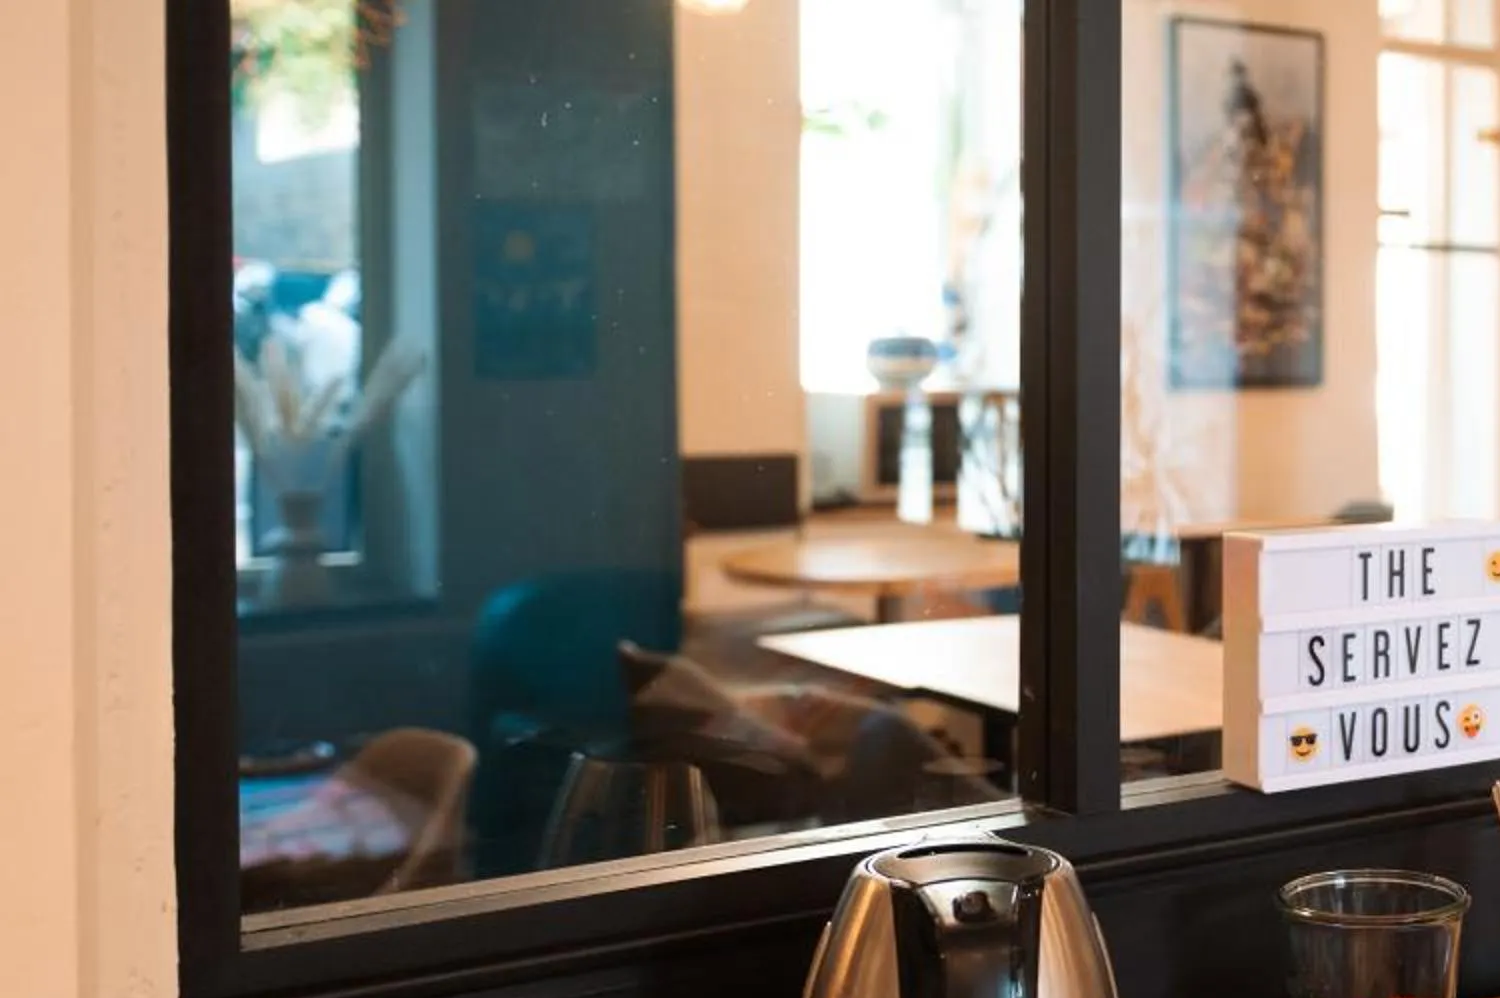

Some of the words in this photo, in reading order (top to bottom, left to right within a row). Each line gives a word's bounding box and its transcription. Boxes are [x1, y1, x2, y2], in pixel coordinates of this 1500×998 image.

[1358, 547, 1435, 601] THE
[1307, 618, 1482, 687] SERVEZ
[1338, 701, 1451, 761] VOUS
